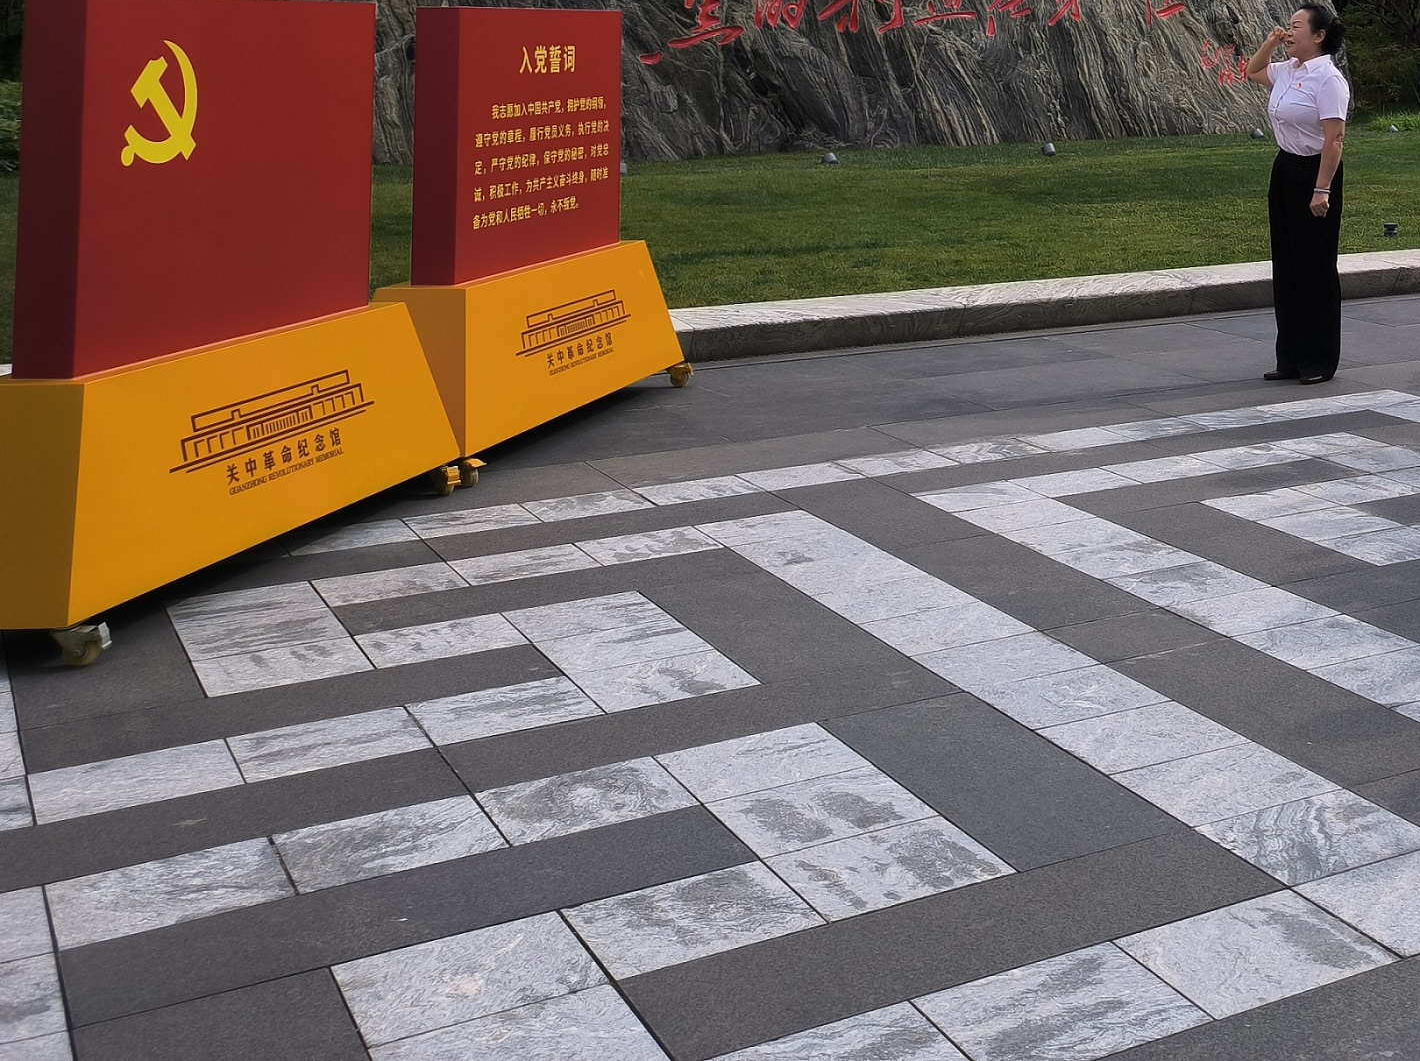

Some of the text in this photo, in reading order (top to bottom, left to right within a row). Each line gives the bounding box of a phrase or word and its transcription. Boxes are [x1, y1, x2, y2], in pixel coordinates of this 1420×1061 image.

[519, 45, 576, 74] 入党誓词
[546, 331, 613, 368] 关中革命纪念馆
[226, 426, 342, 485] 关中革命纪念馆
[229, 447, 345, 496] GUANZHONG REVOLUTIONARY MEMORIAL
